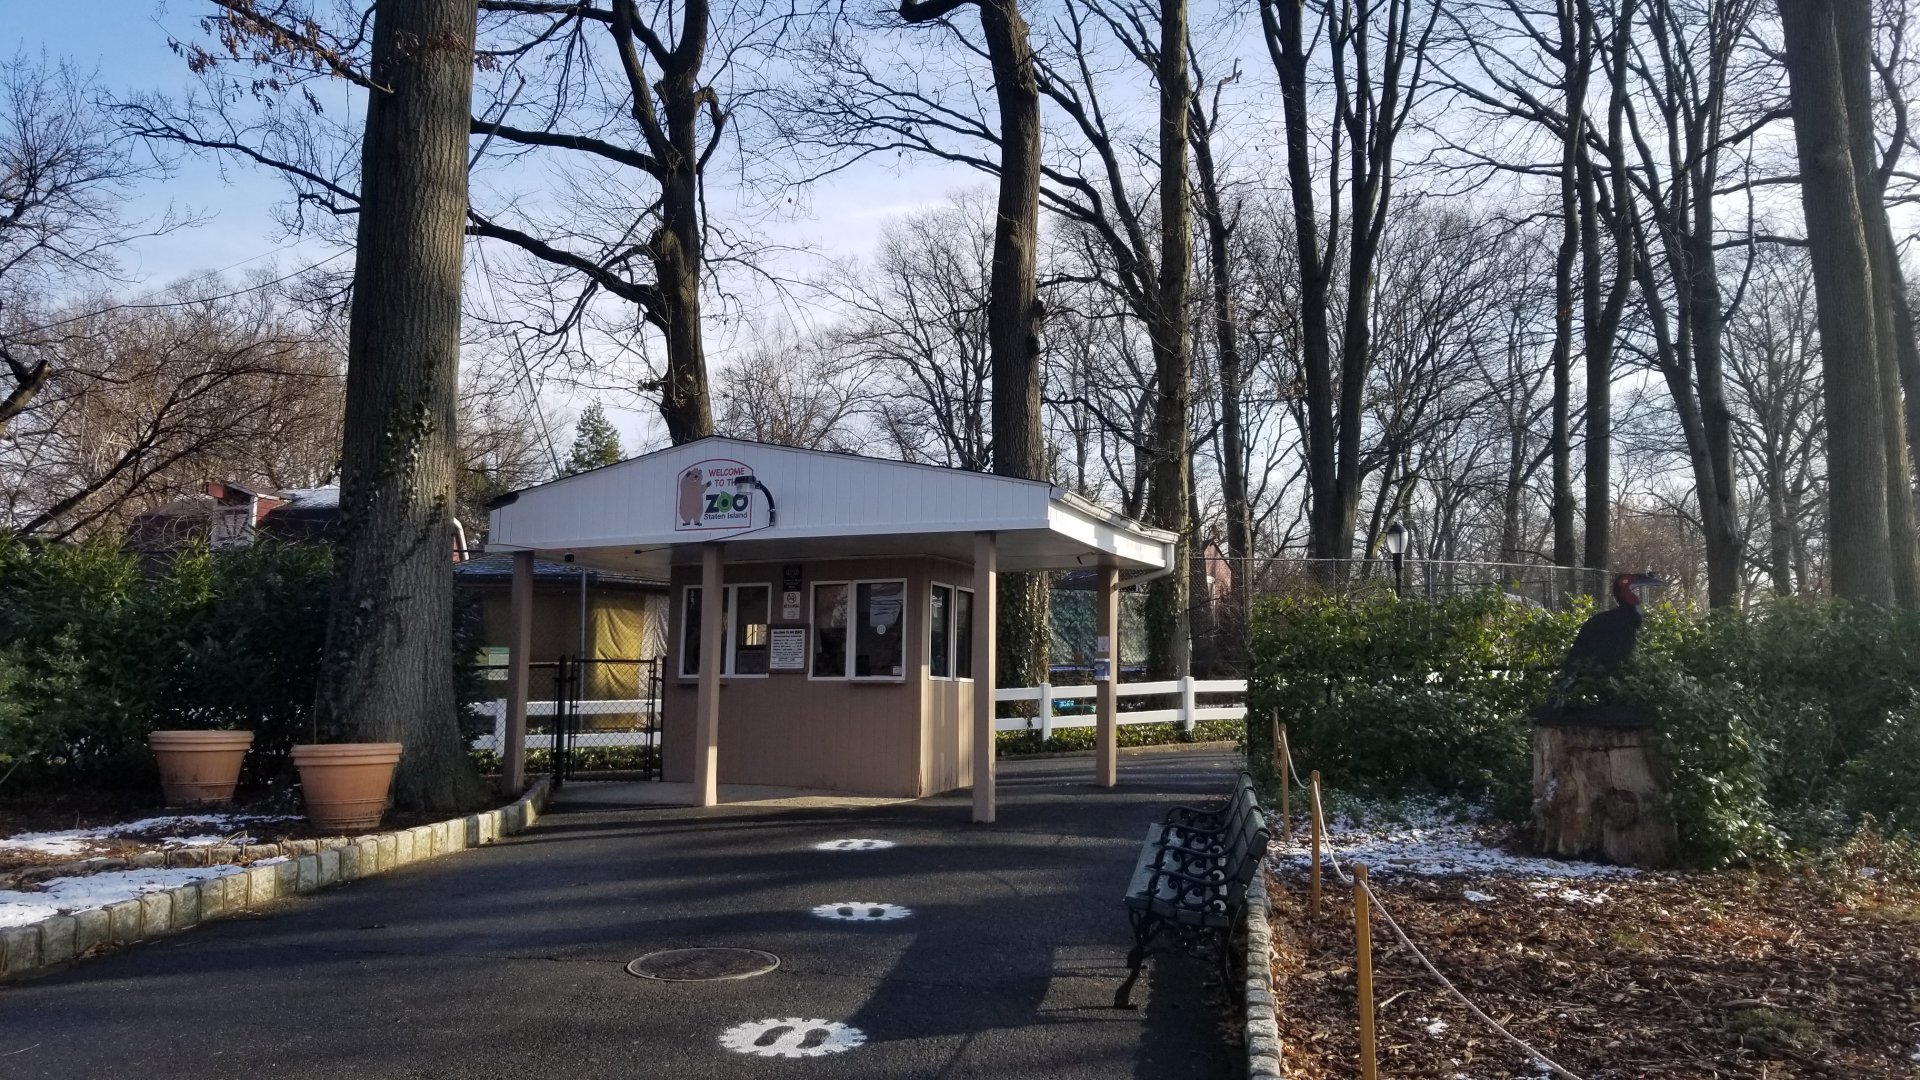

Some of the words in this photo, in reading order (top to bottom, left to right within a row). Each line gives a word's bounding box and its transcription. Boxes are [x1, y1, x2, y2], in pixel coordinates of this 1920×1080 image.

[709, 467, 744, 477] WELCOME
[714, 479, 724, 487] TO
[705, 491, 748, 513] ZOO
